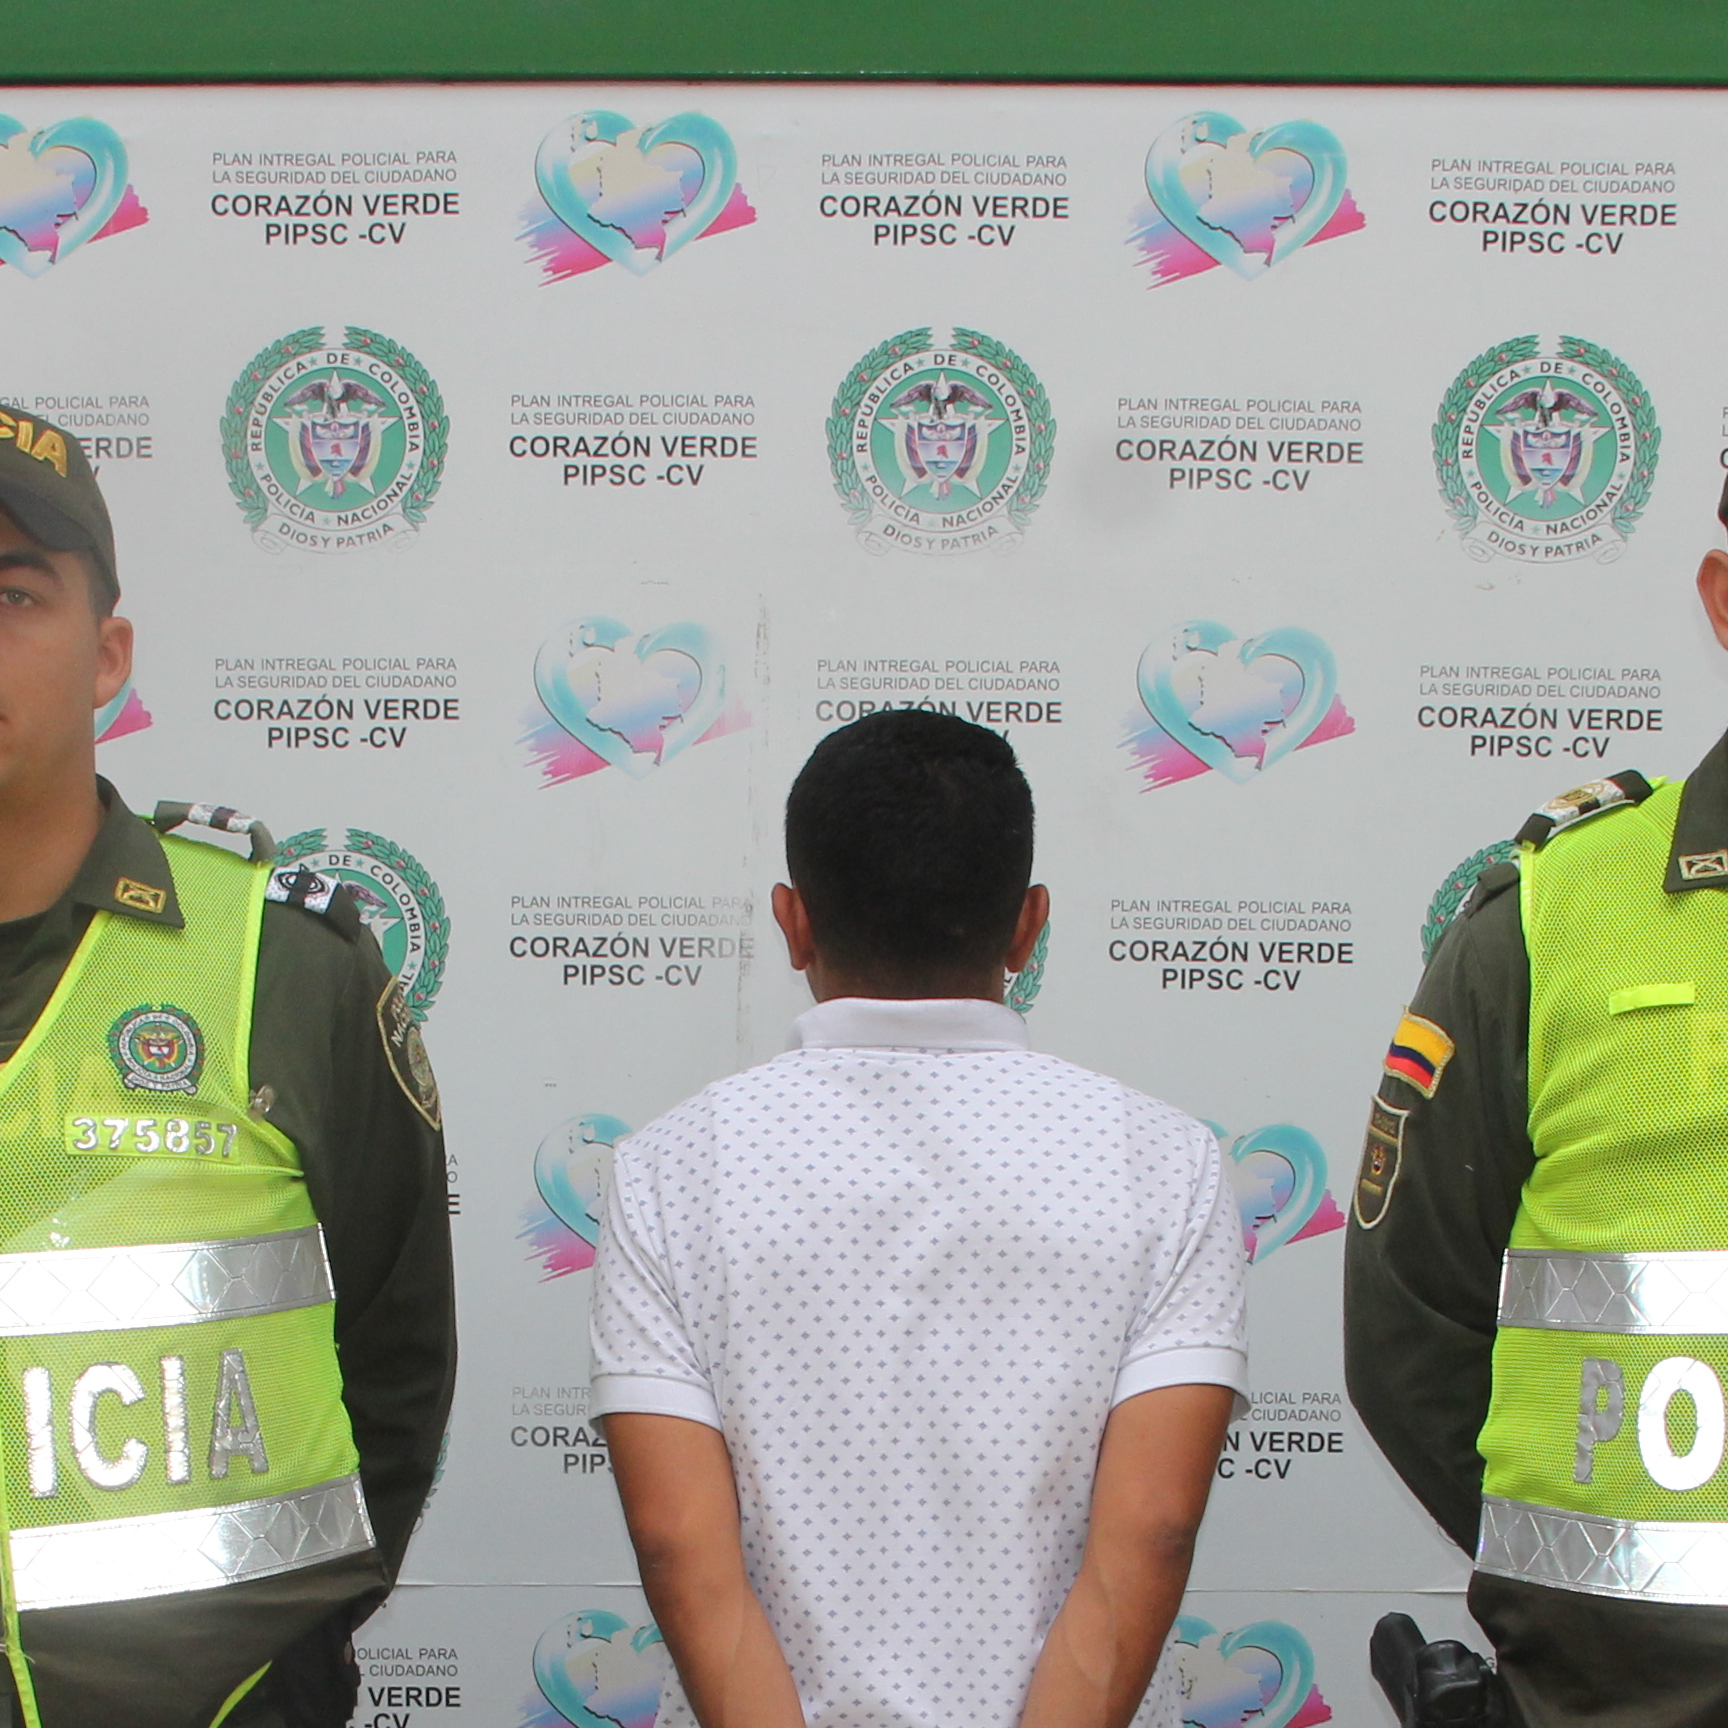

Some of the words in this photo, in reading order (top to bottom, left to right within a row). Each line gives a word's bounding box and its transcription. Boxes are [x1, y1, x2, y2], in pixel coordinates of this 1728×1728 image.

[1116, 434, 1257, 462] CORAZÓN
[1267, 440, 1364, 464] VERDE
[1169, 468, 1252, 490] PIPSC
[1420, 665, 1459, 678] PLAN
[1466, 666, 1541, 680] INTREGAL
[1547, 667, 1615, 681] POLICIAL
[1621, 668, 1661, 681] PARA
[1420, 683, 1438, 695] LA
[1442, 683, 1532, 696] SEGURIDAD
[1537, 685, 1565, 697] DEL
[1570, 685, 1661, 699] CIUDADANO
[1417, 702, 1558, 730] CORAZÓN
[1567, 708, 1663, 731] VERDE
[1470, 735, 1553, 758] PIPSC
[1109, 935, 1249, 963] CORAZÓN
[1258, 941, 1354, 964] VERDE
[1162, 968, 1244, 991] PIPSC
[72, 1117, 238, 1158] 375857
